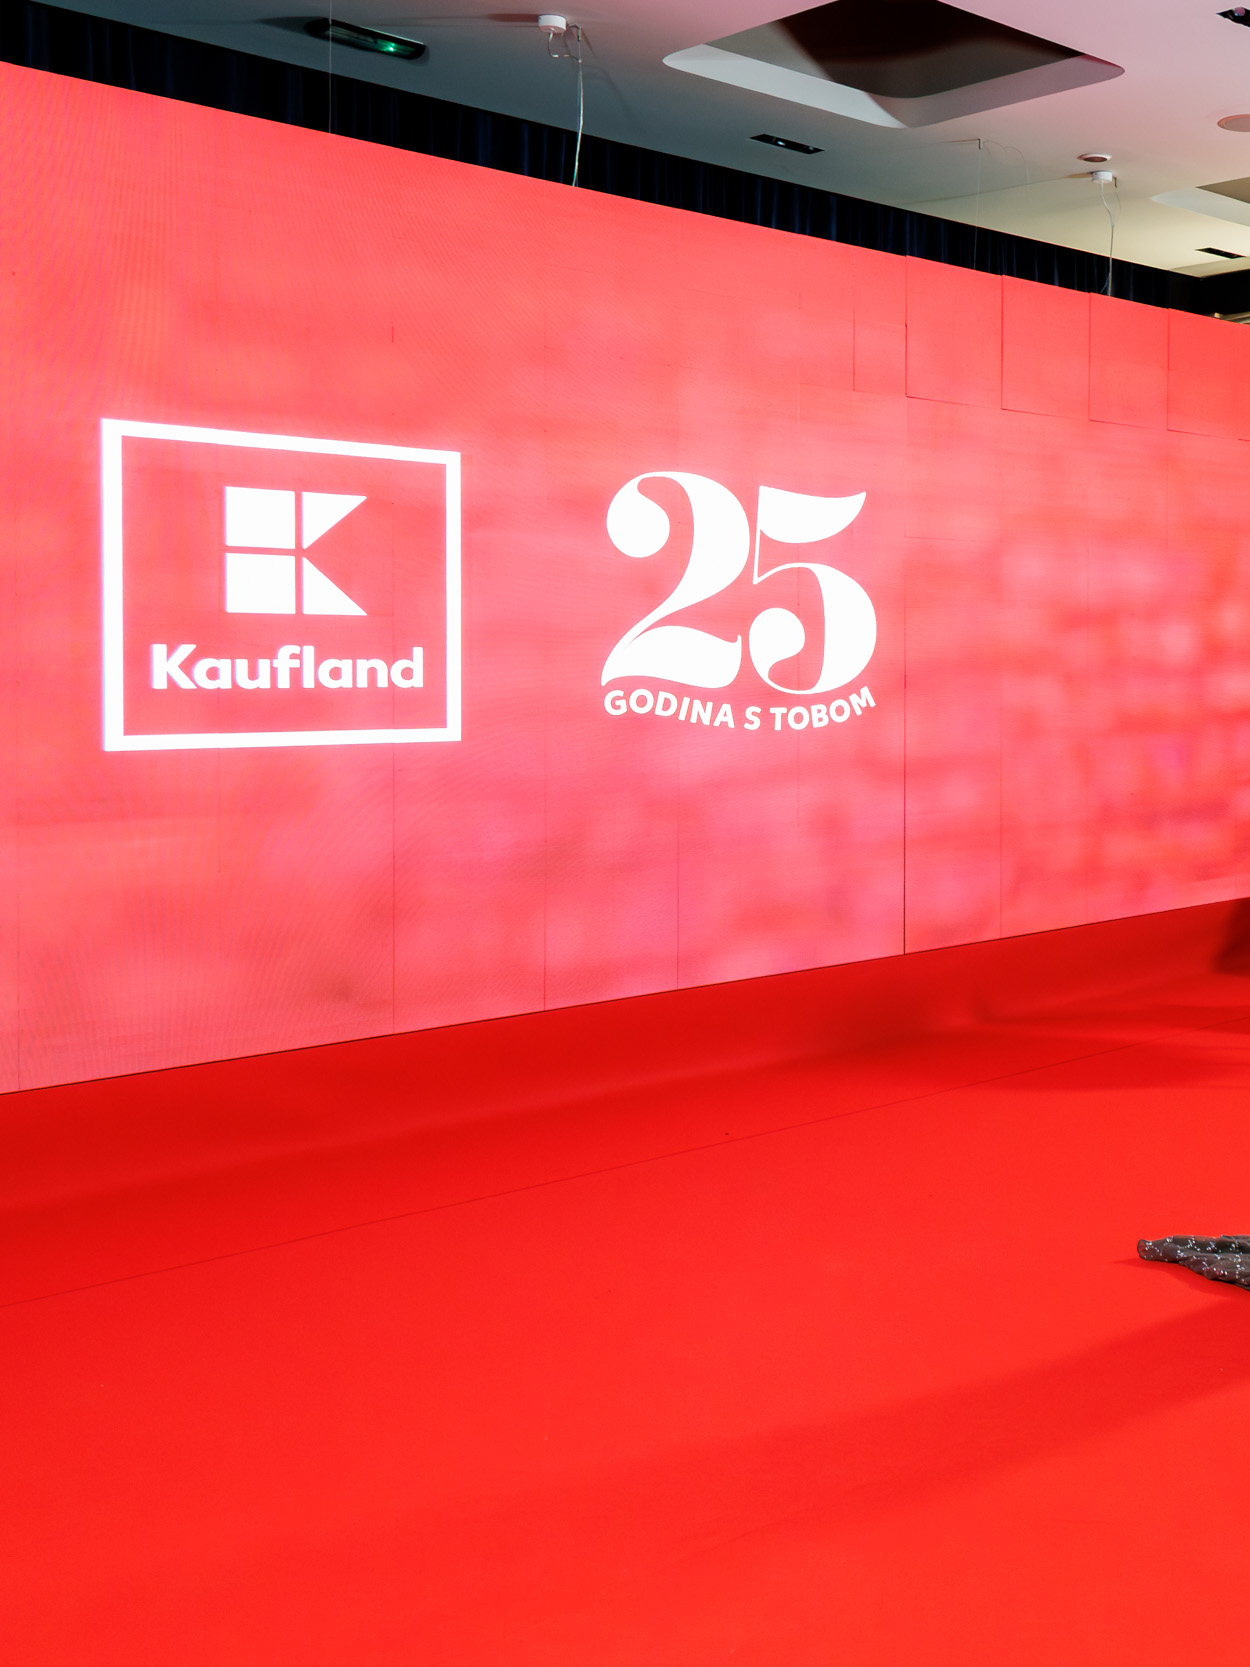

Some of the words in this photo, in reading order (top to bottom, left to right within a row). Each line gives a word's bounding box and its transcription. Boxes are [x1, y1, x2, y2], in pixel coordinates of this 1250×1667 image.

[600, 470, 877, 695] 25
[151, 643, 424, 690] Kaufland
[603, 688, 735, 729] GODINA
[743, 705, 762, 731] S
[769, 685, 876, 731] TOBOM
